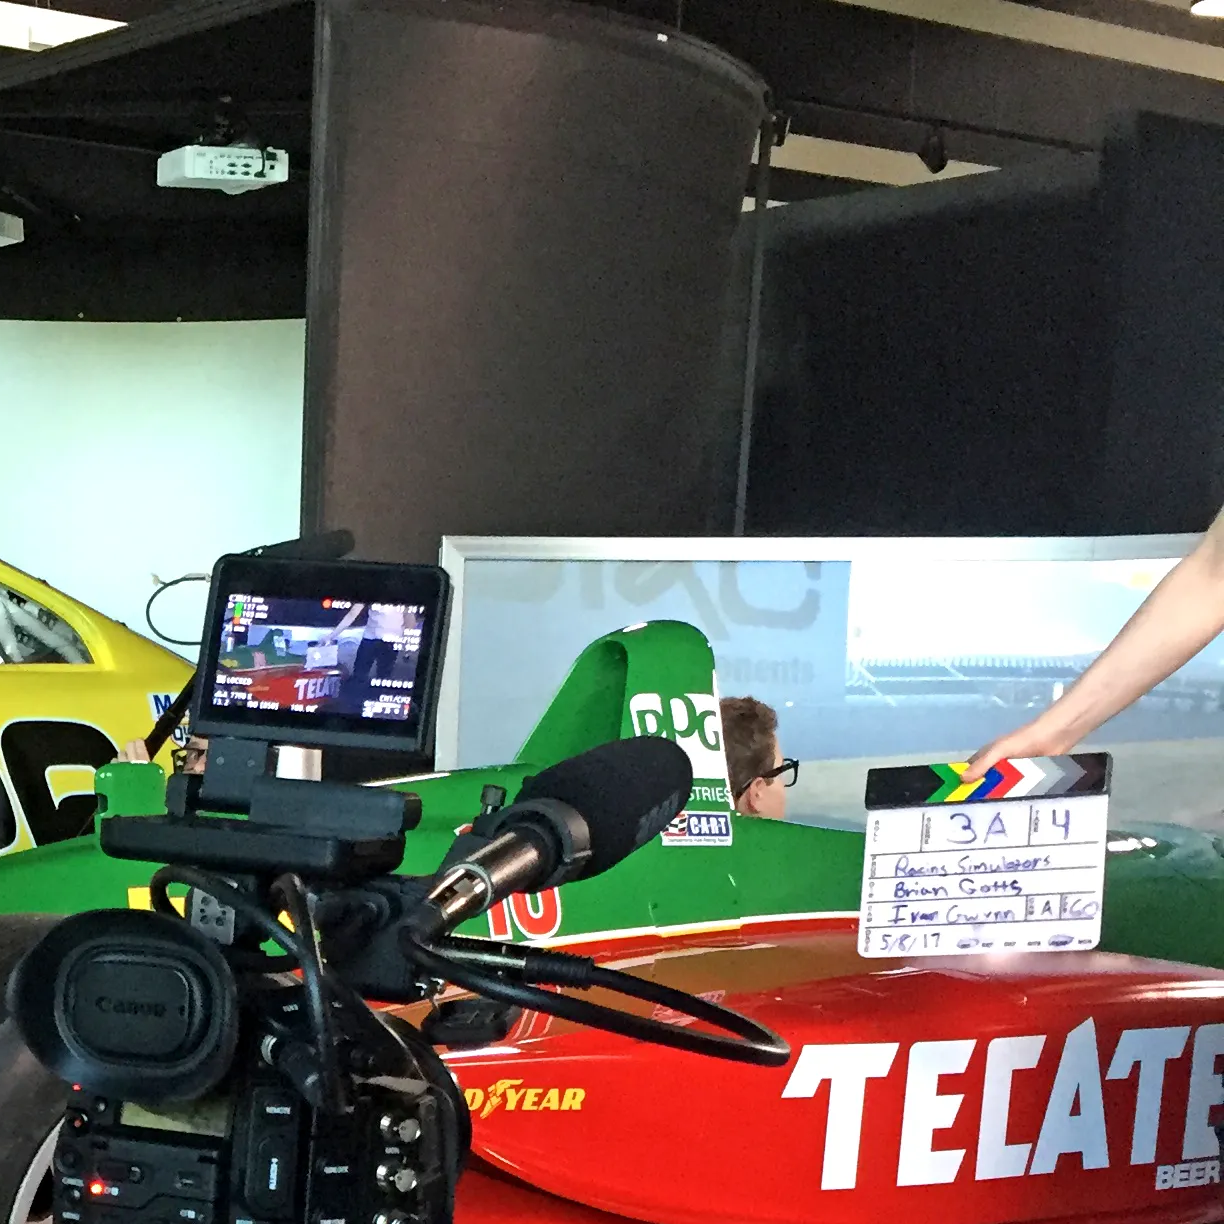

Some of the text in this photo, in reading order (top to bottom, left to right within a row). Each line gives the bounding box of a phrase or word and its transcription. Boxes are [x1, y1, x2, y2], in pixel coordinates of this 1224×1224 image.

[689, 815, 727, 835] CART
[1052, 809, 1070, 840] 4
[894, 881, 948, 898] Brian
[1041, 900, 1052, 915] A
[781, 1017, 1224, 1190] TECATE
[1155, 1161, 1220, 1190] BEER
